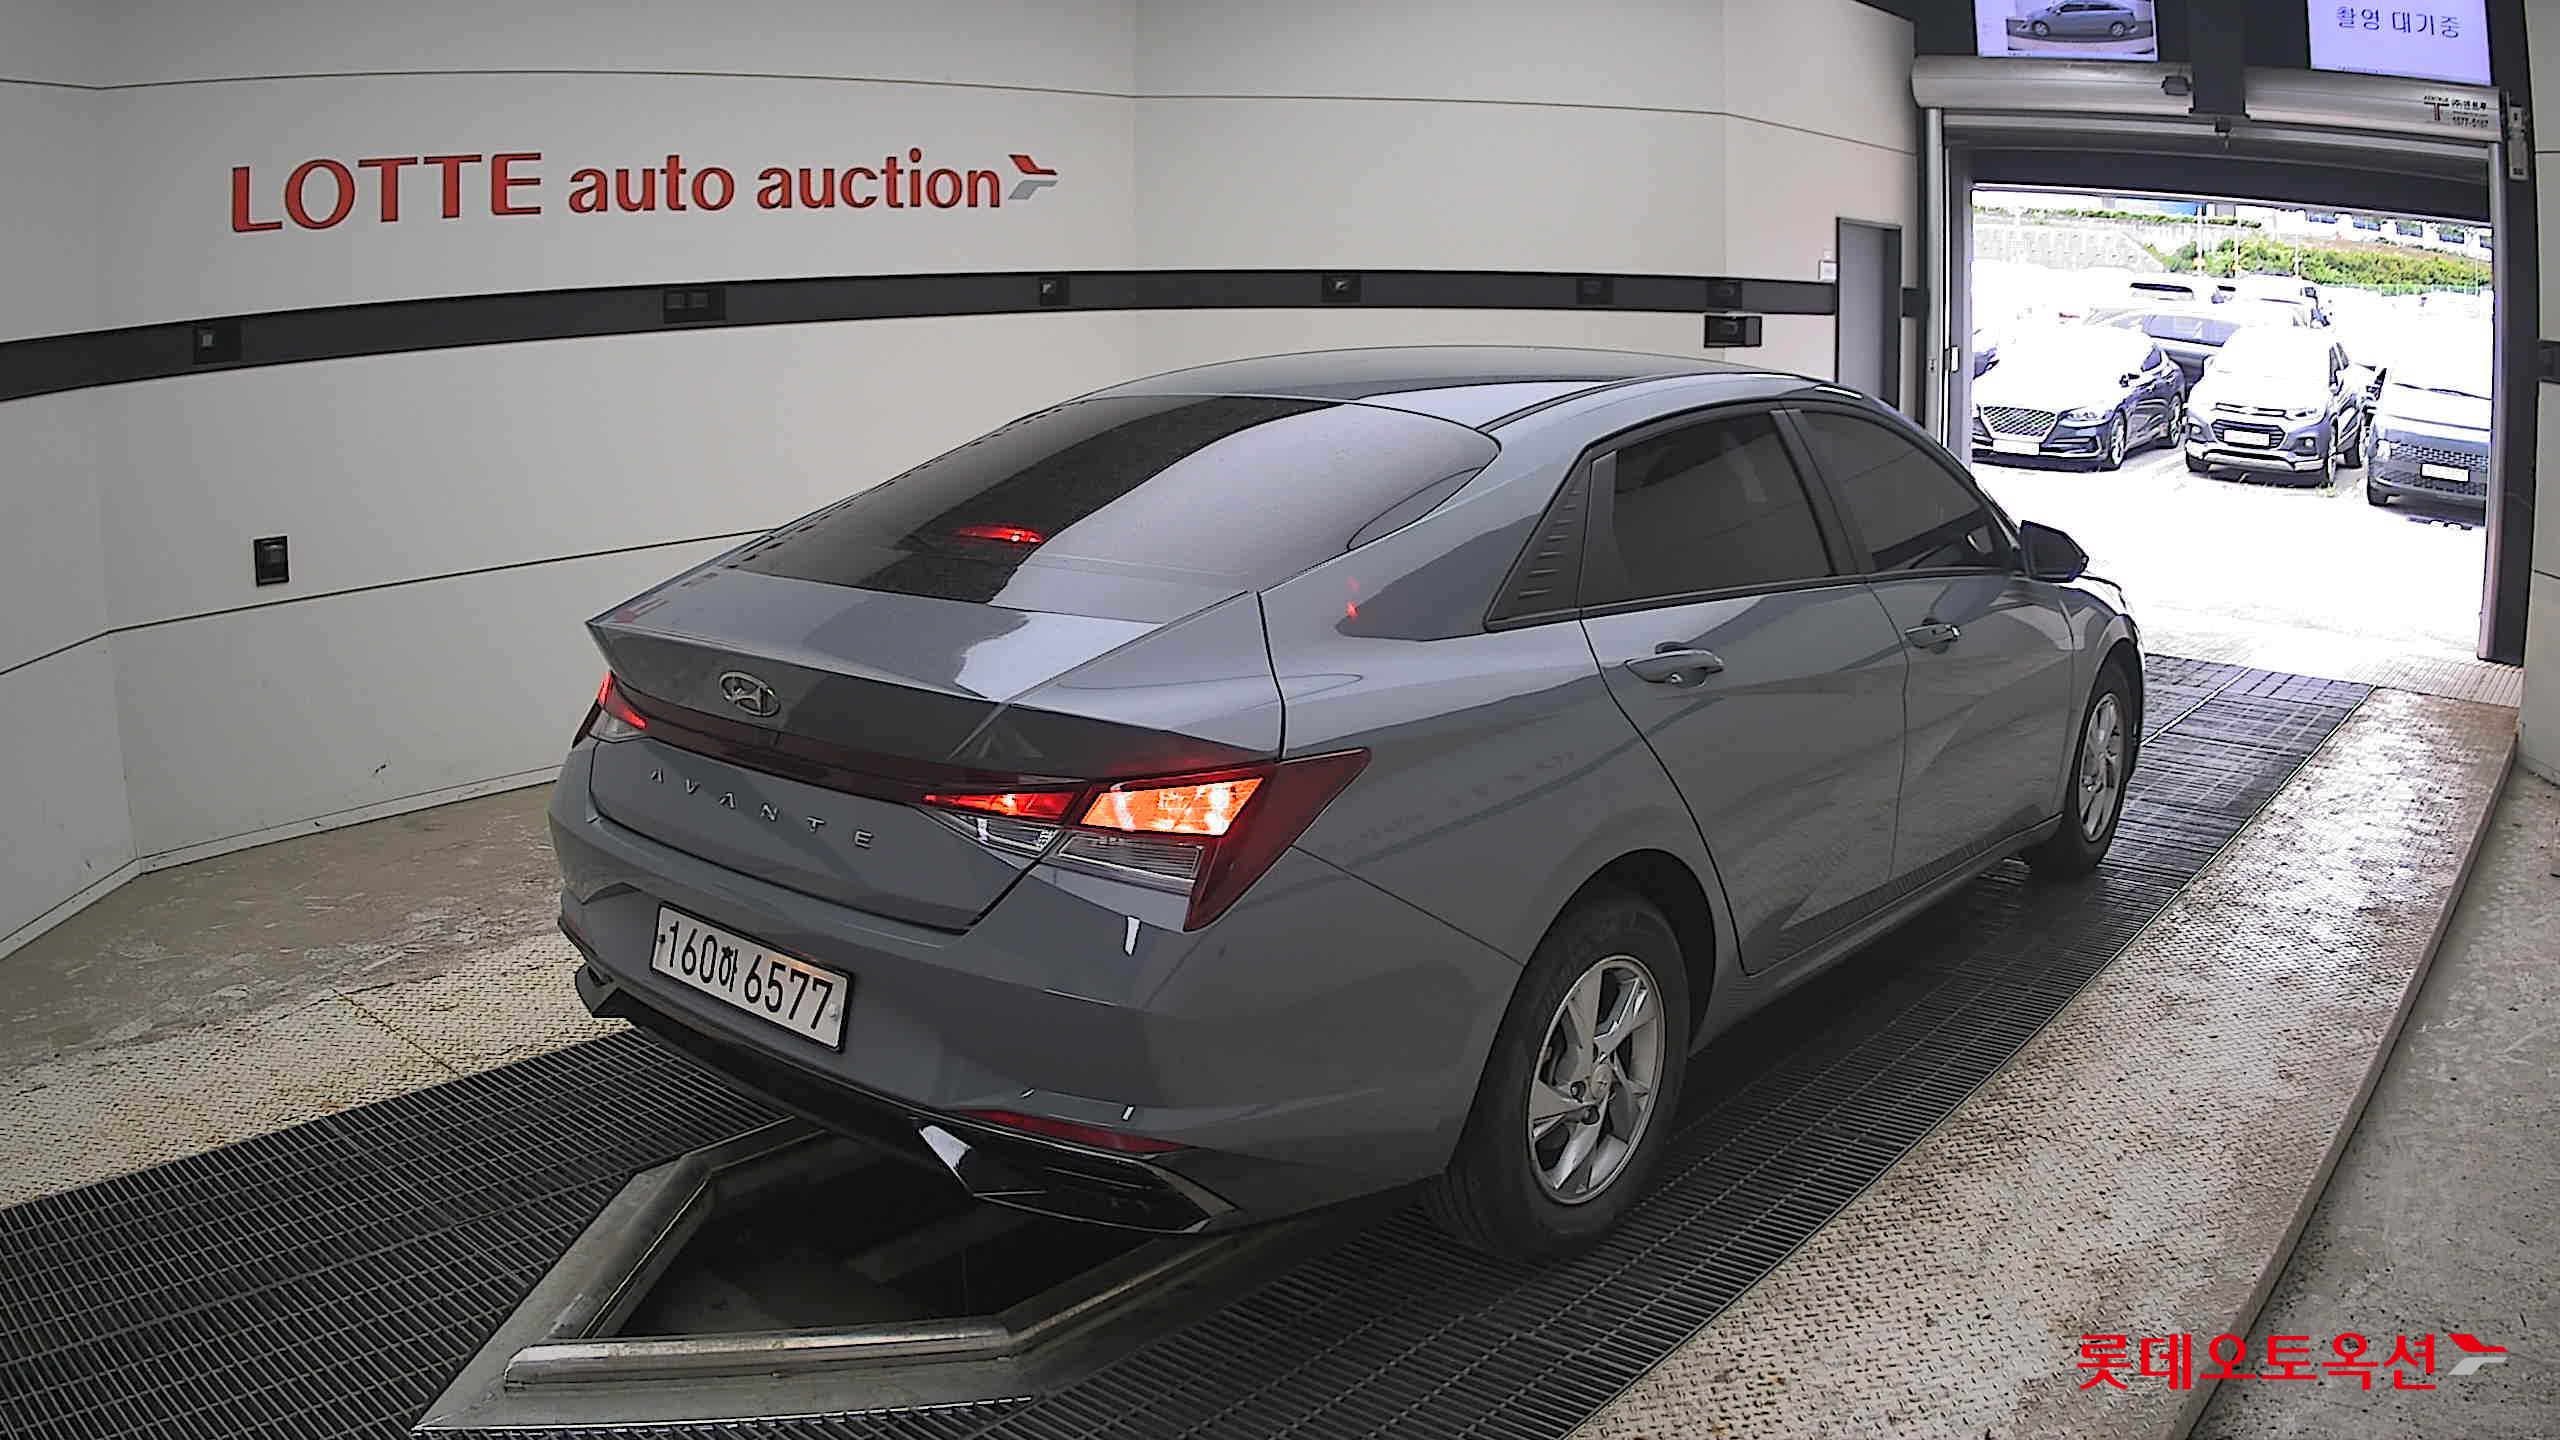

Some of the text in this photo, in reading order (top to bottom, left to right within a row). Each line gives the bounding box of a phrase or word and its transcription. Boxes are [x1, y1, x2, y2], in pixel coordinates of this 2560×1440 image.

[2336, 5, 2460, 39] 촬영 대기중
[231, 147, 1001, 234] LOTTE auto auction
[650, 768, 874, 849] AVANTE
[668, 919, 835, 1031] 160하 6577
